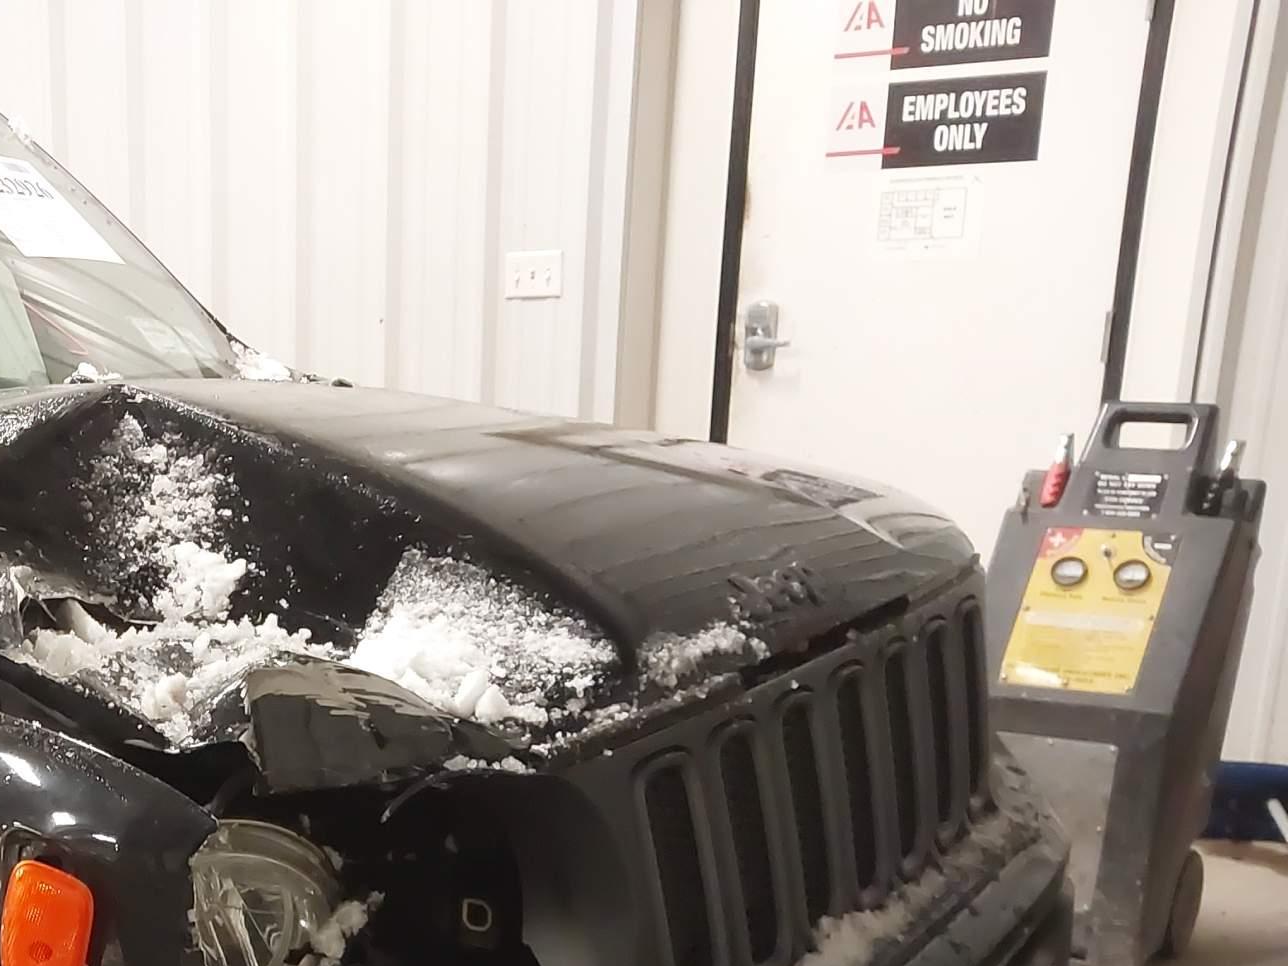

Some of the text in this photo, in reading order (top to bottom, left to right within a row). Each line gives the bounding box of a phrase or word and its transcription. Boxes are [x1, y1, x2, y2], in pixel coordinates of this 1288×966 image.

[919, 17, 1022, 53] SMOKING
[901, 87, 1027, 122] EMPLOYEES
[933, 122, 989, 152] ONLY
